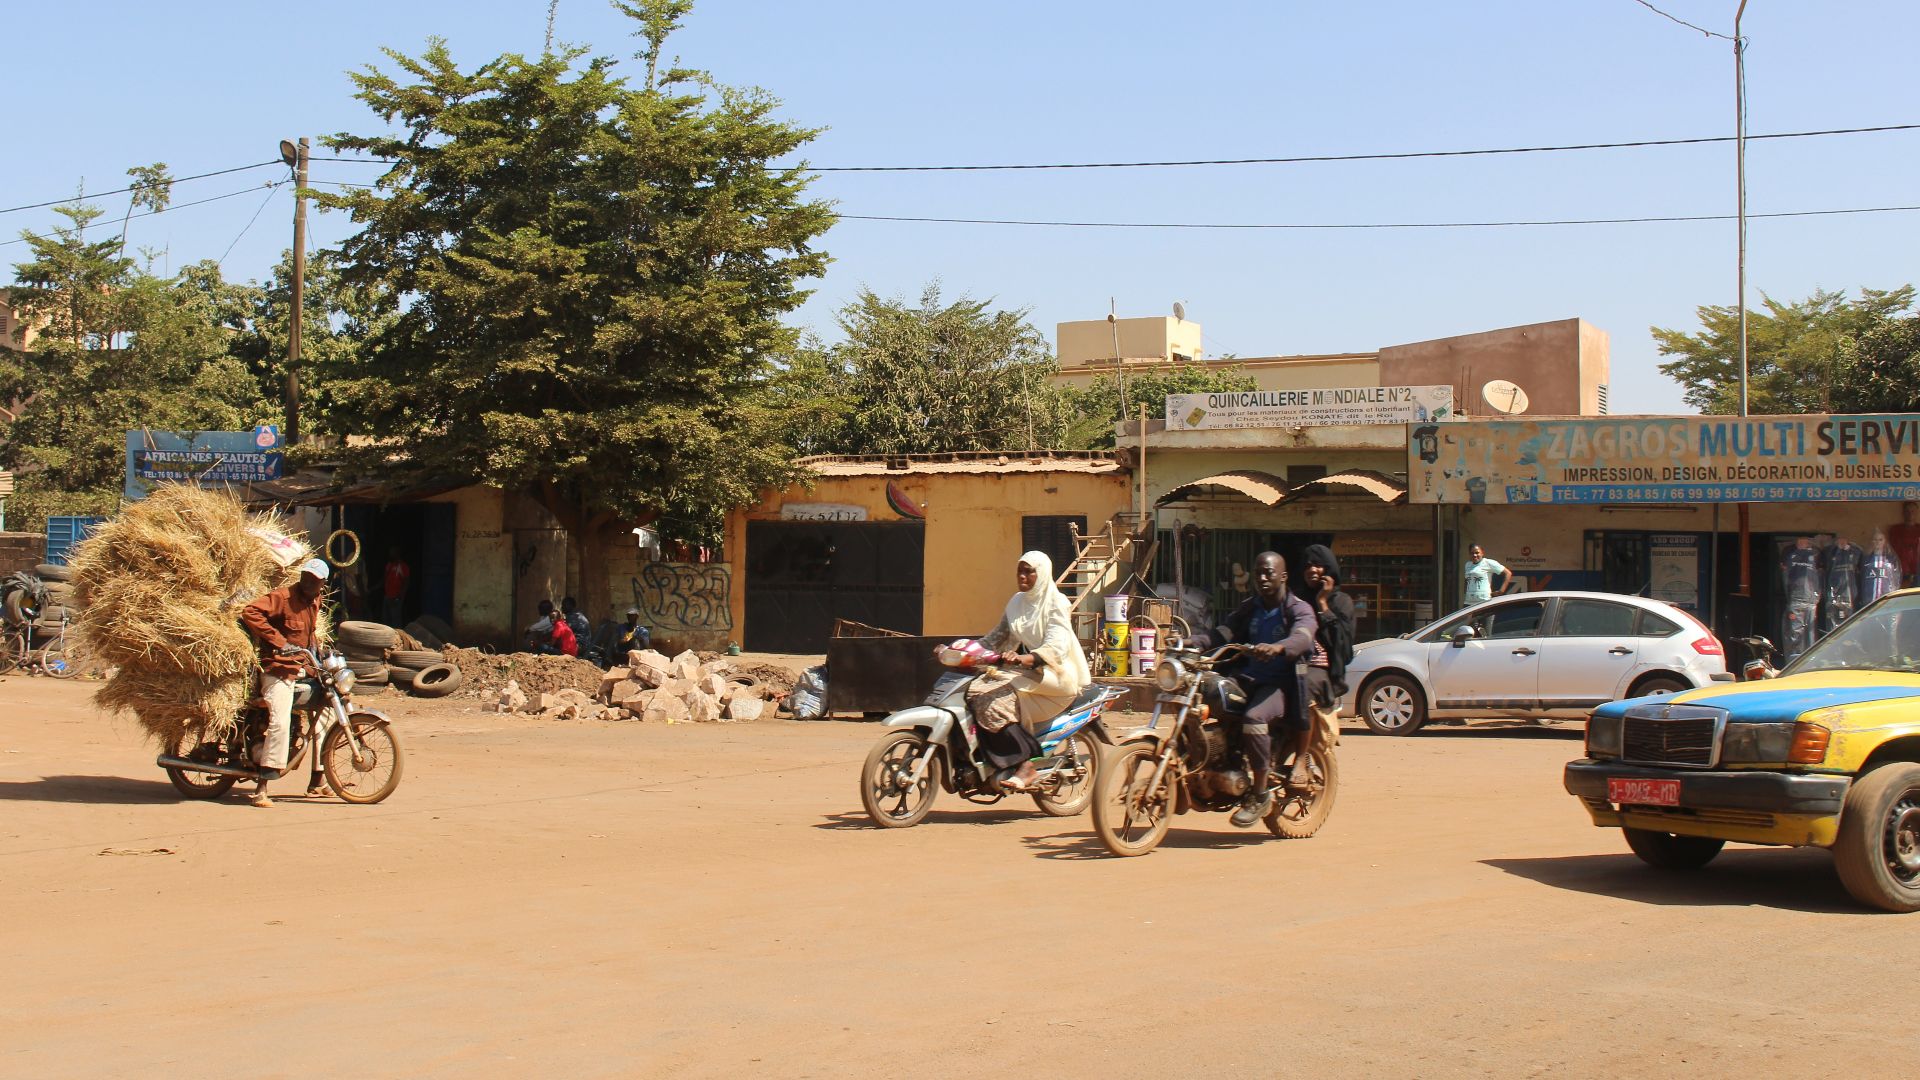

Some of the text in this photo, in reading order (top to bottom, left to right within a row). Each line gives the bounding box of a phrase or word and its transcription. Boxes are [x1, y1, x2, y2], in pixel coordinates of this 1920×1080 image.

[1208, 391, 1309, 409] QUINCAILLERIE
[1388, 387, 1411, 401] N°2
[1546, 423, 1688, 460] ZAGROS
[1700, 421, 1804, 457] MULTI
[144, 451, 212, 463] AFRICAINES
[1563, 462, 1912, 483] IMPRESSION, DESIGN, DÉCORATION, BUSINESS
[1591, 489, 1604, 500] 77
[1608, 489, 1623, 499] 83
[1626, 489, 1641, 499] 84
[1644, 488, 1658, 499] 85
[1670, 488, 1685, 499] 66
[1688, 487, 1703, 499] 99
[1707, 487, 1721, 499] 99
[1725, 487, 1739, 499] 58
[1751, 487, 1765, 498] 50
[1769, 487, 1784, 498] 50
[1788, 487, 1802, 498] 77
[1806, 487, 1821, 498] 83
